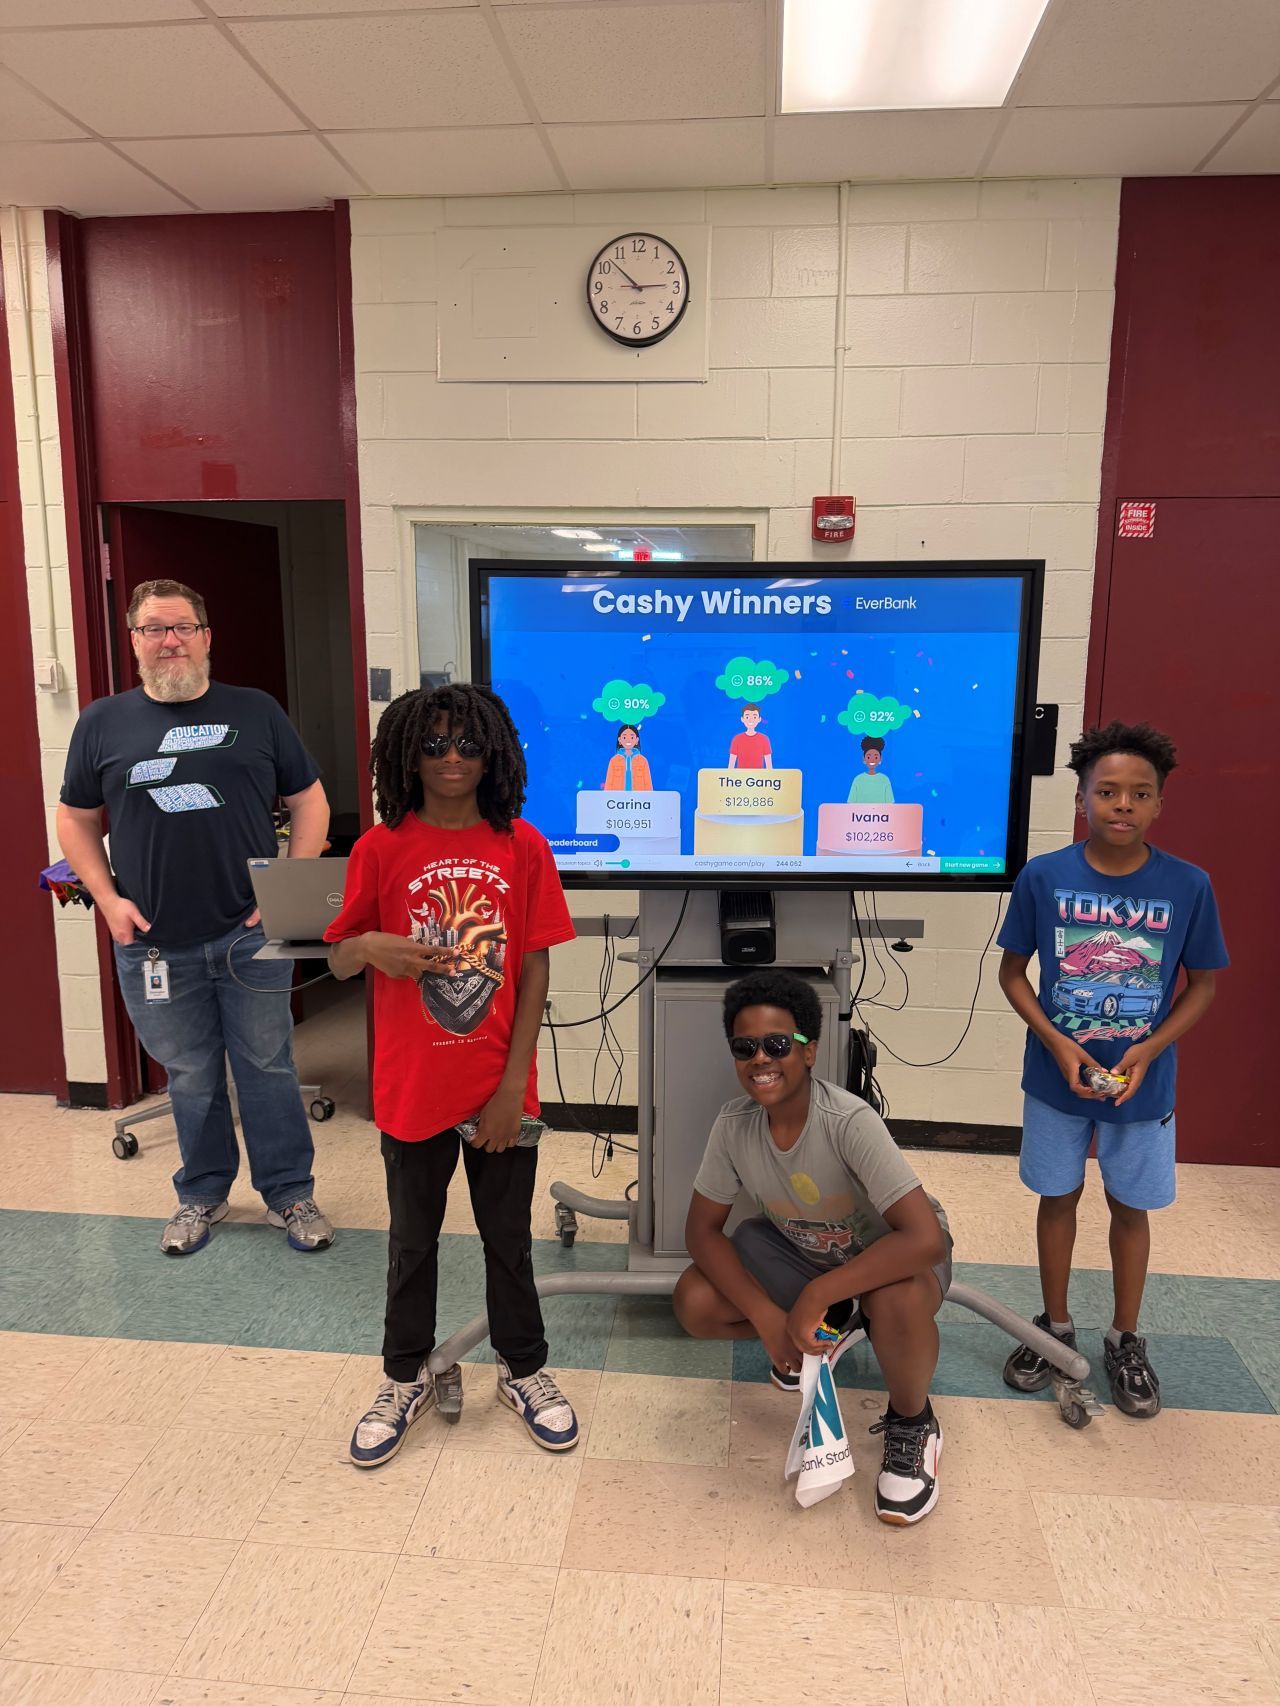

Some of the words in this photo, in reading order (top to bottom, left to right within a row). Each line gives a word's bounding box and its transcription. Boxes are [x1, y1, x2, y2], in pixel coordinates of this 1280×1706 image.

[615, 246, 625, 260] 11
[631, 239, 647, 253] 12
[653, 246, 660, 260] 1
[598, 261, 611, 275] 10
[666, 260, 676, 274] 2
[594, 281, 604, 295] 9
[672, 280, 681, 295] 3
[600, 300, 609, 314] 8
[665, 300, 675, 314] 4
[615, 316, 624, 331] 7
[633, 321, 642, 335] 6
[651, 316, 661, 330] 5
[1127, 509, 1149, 518] FIRE
[592, 588, 694, 622] Cashy
[701, 587, 832, 615] Winners
[855, 596, 917, 610] EverBank
[746, 675, 773, 686] 86%
[623, 698, 650, 709] 90%
[869, 711, 895, 722] 92%
[170, 724, 229, 738] EDUCATION
[718, 777, 743, 787] The
[745, 777, 782, 791] Gang
[606, 798, 651, 810] Carina
[725, 797, 774, 807] $129,886
[606, 819, 651, 830] $106,951
[851, 812, 889, 823] Ivana
[845, 832, 894, 843] $102,286
[423, 858, 460, 872] HEART
[479, 860, 501, 873] THE
[408, 866, 511, 896] STREETZ
[1054, 889, 1174, 933] TOKYO
